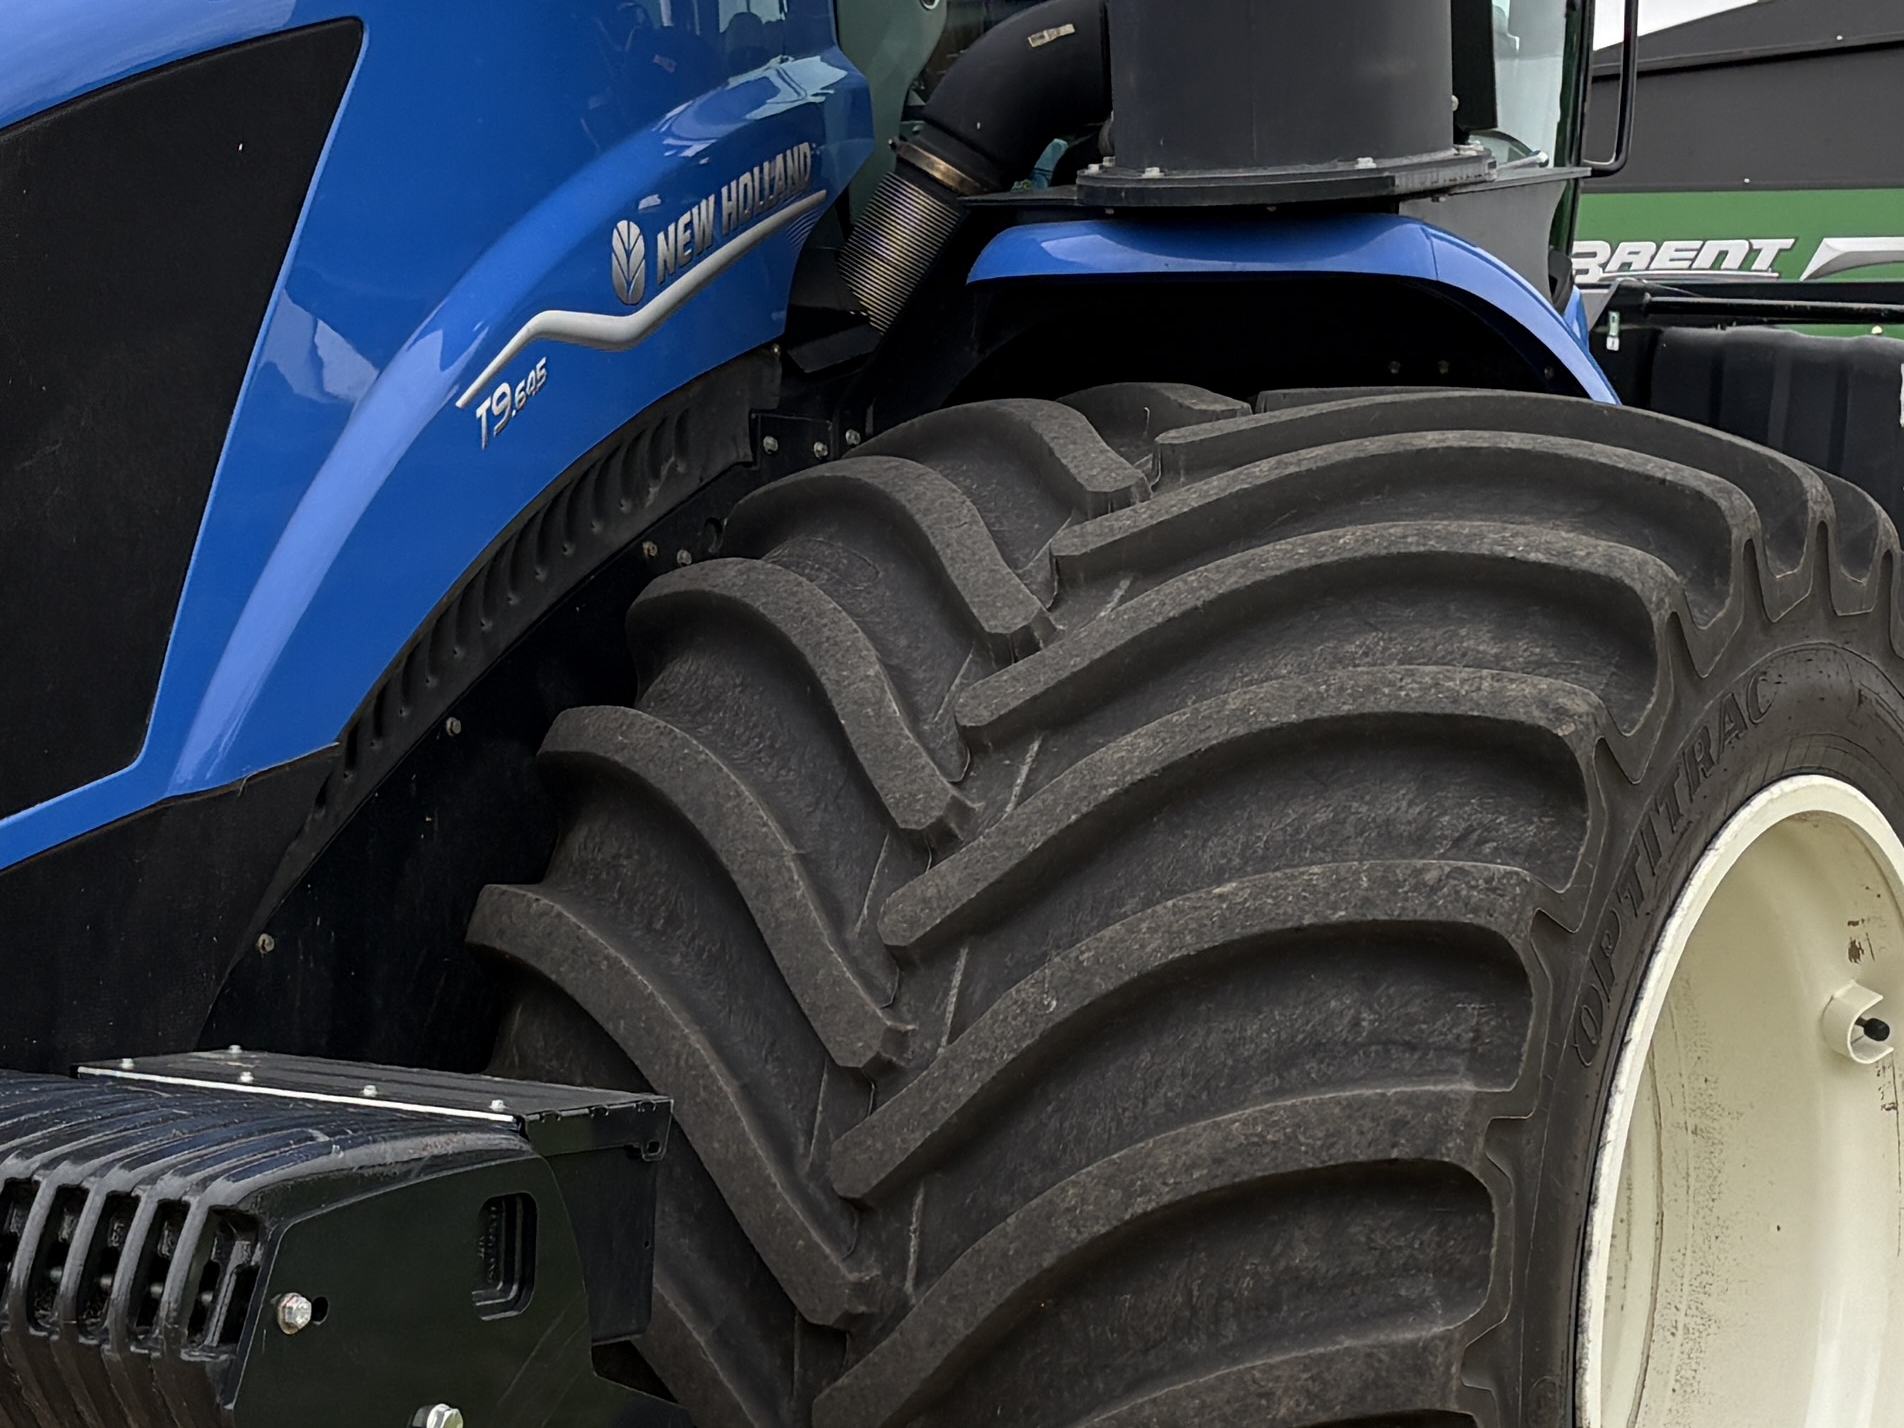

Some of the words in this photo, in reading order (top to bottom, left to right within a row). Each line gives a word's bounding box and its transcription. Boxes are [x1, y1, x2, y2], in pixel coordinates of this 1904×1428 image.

[657, 193, 715, 285] NEW
[721, 142, 811, 236] HOLLAND
[1572, 238, 1795, 283] BRENT
[476, 356, 547, 449] T9.645
[1573, 673, 1778, 1067] OPTITRAC
